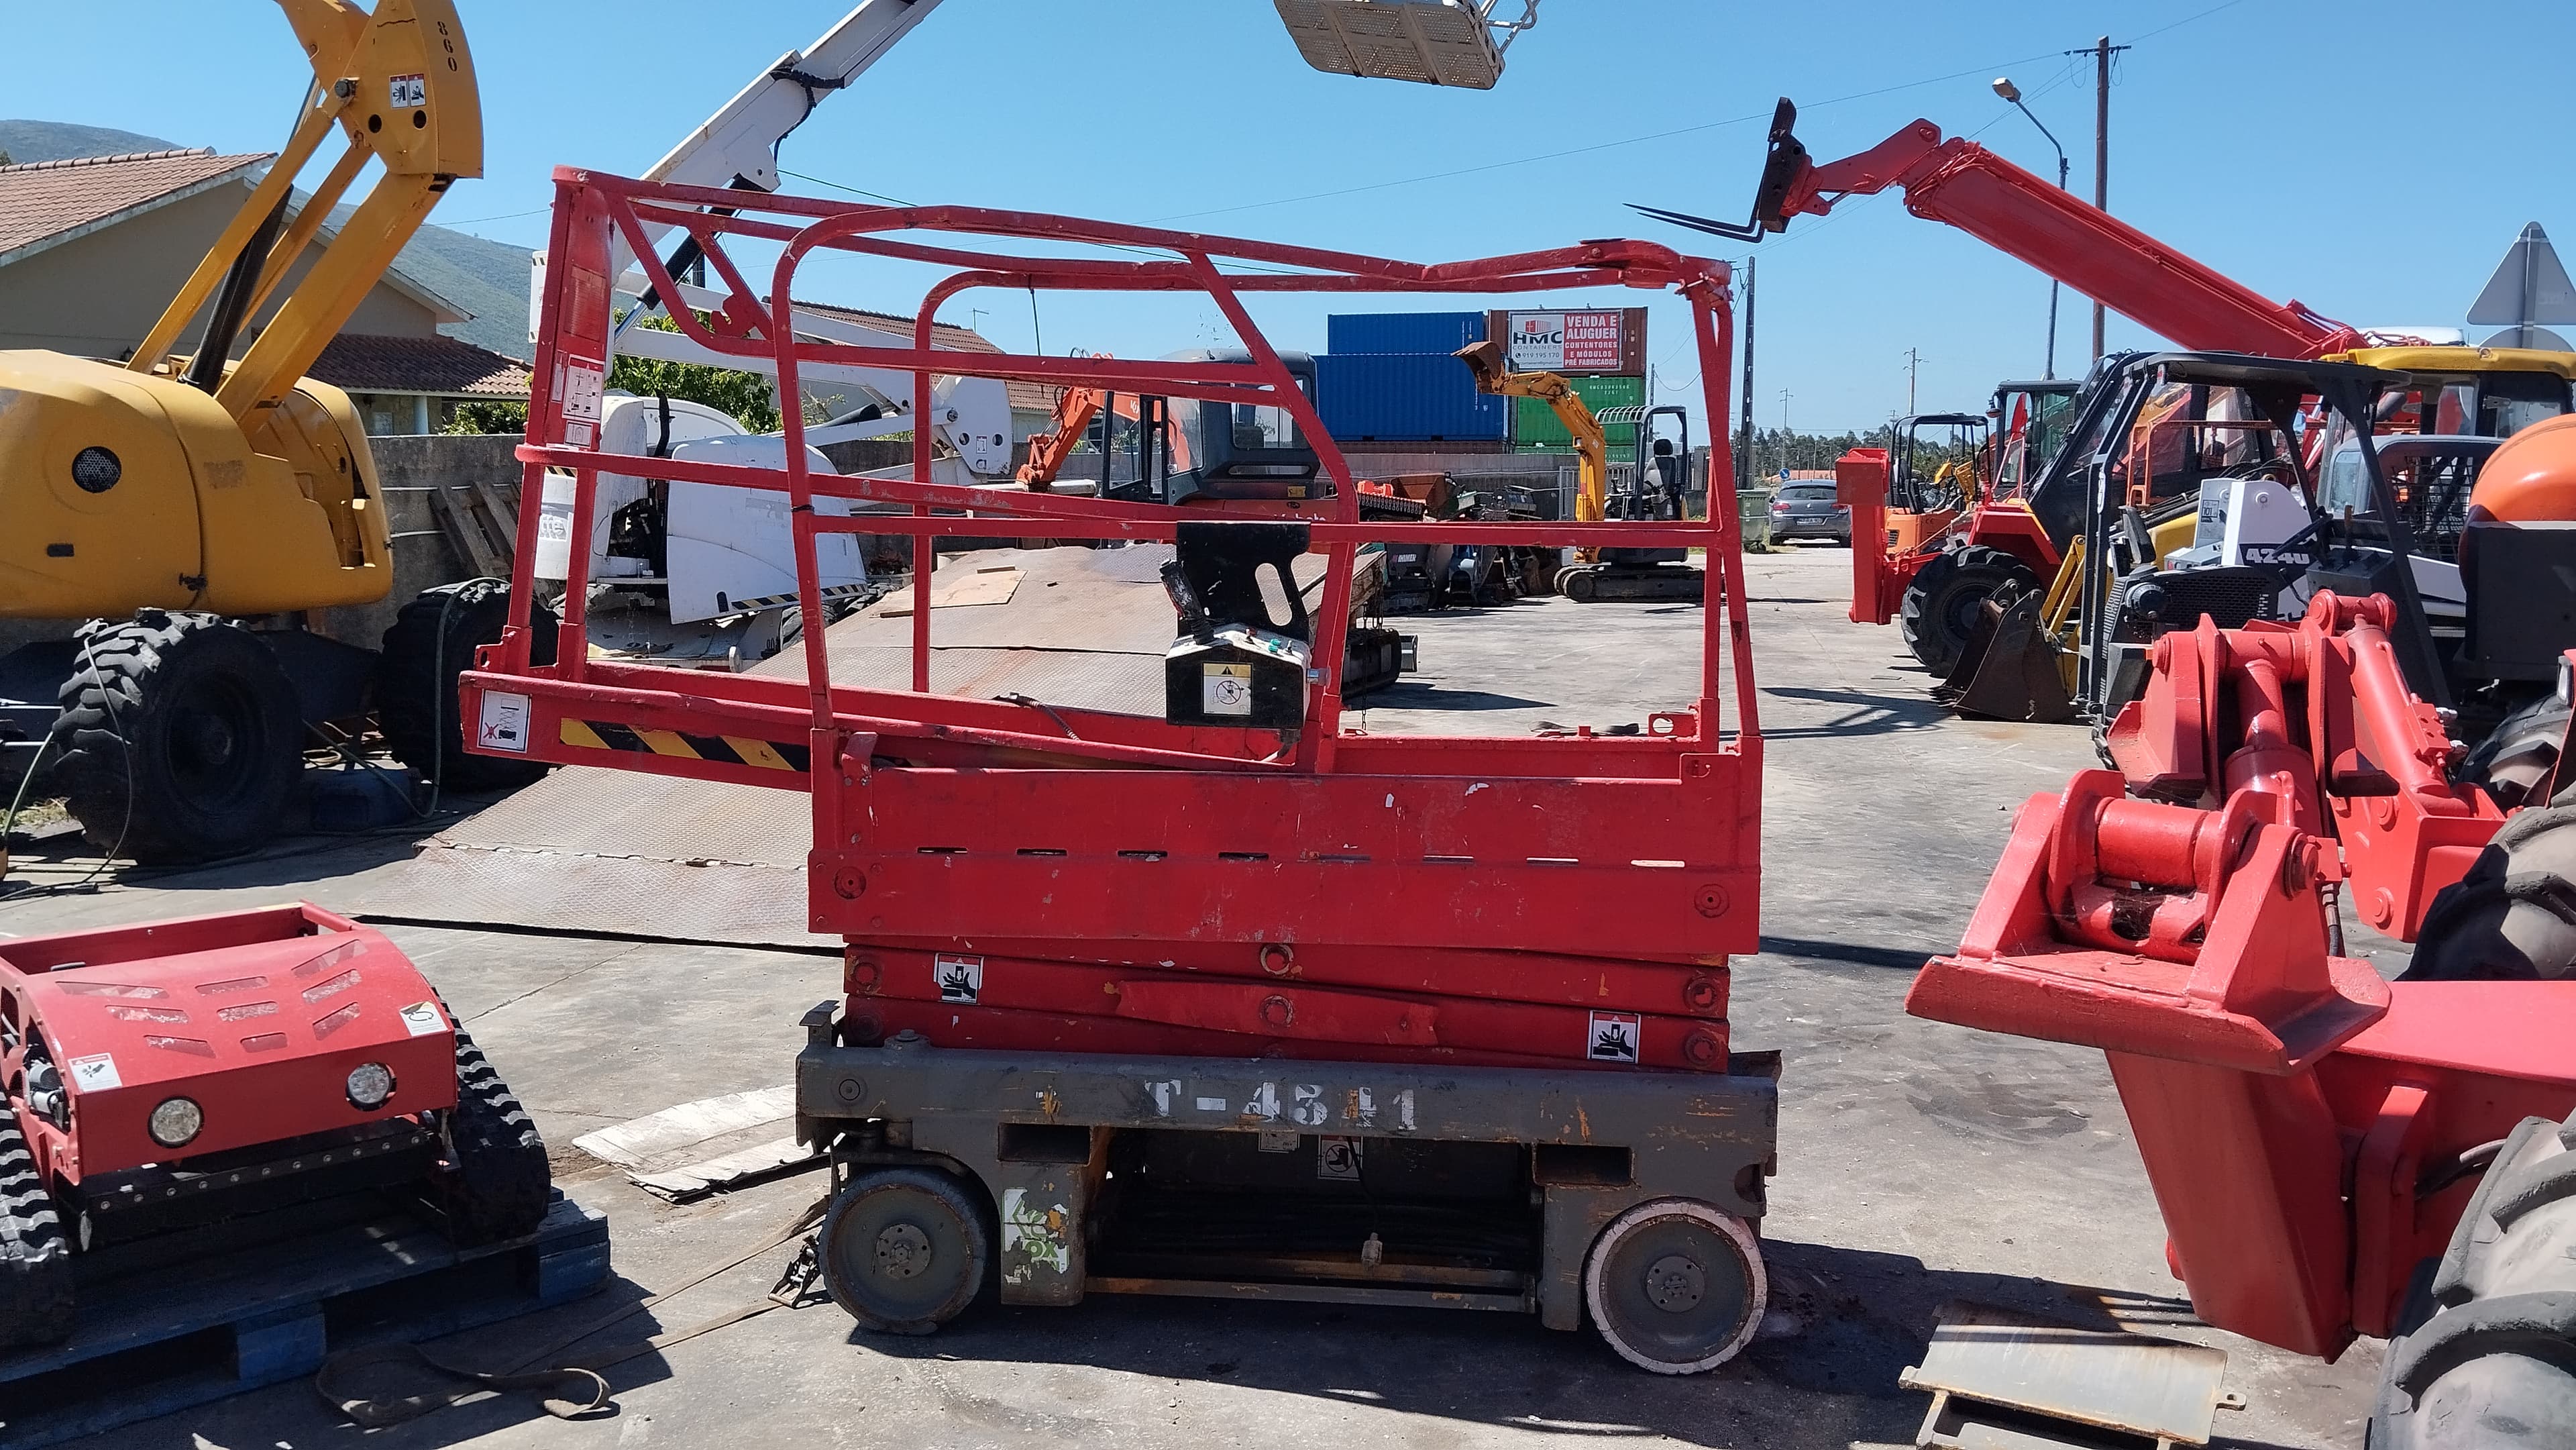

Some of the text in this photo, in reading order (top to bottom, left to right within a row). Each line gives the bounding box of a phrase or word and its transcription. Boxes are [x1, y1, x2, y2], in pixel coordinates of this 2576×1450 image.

[1567, 315, 1617, 327] VENDA E
[1513, 331, 1562, 344] HMC
[1566, 328, 1617, 340] ALUGUER
[1576, 350, 1612, 358] MÓDULOS
[1565, 358, 1577, 366] PRÉ
